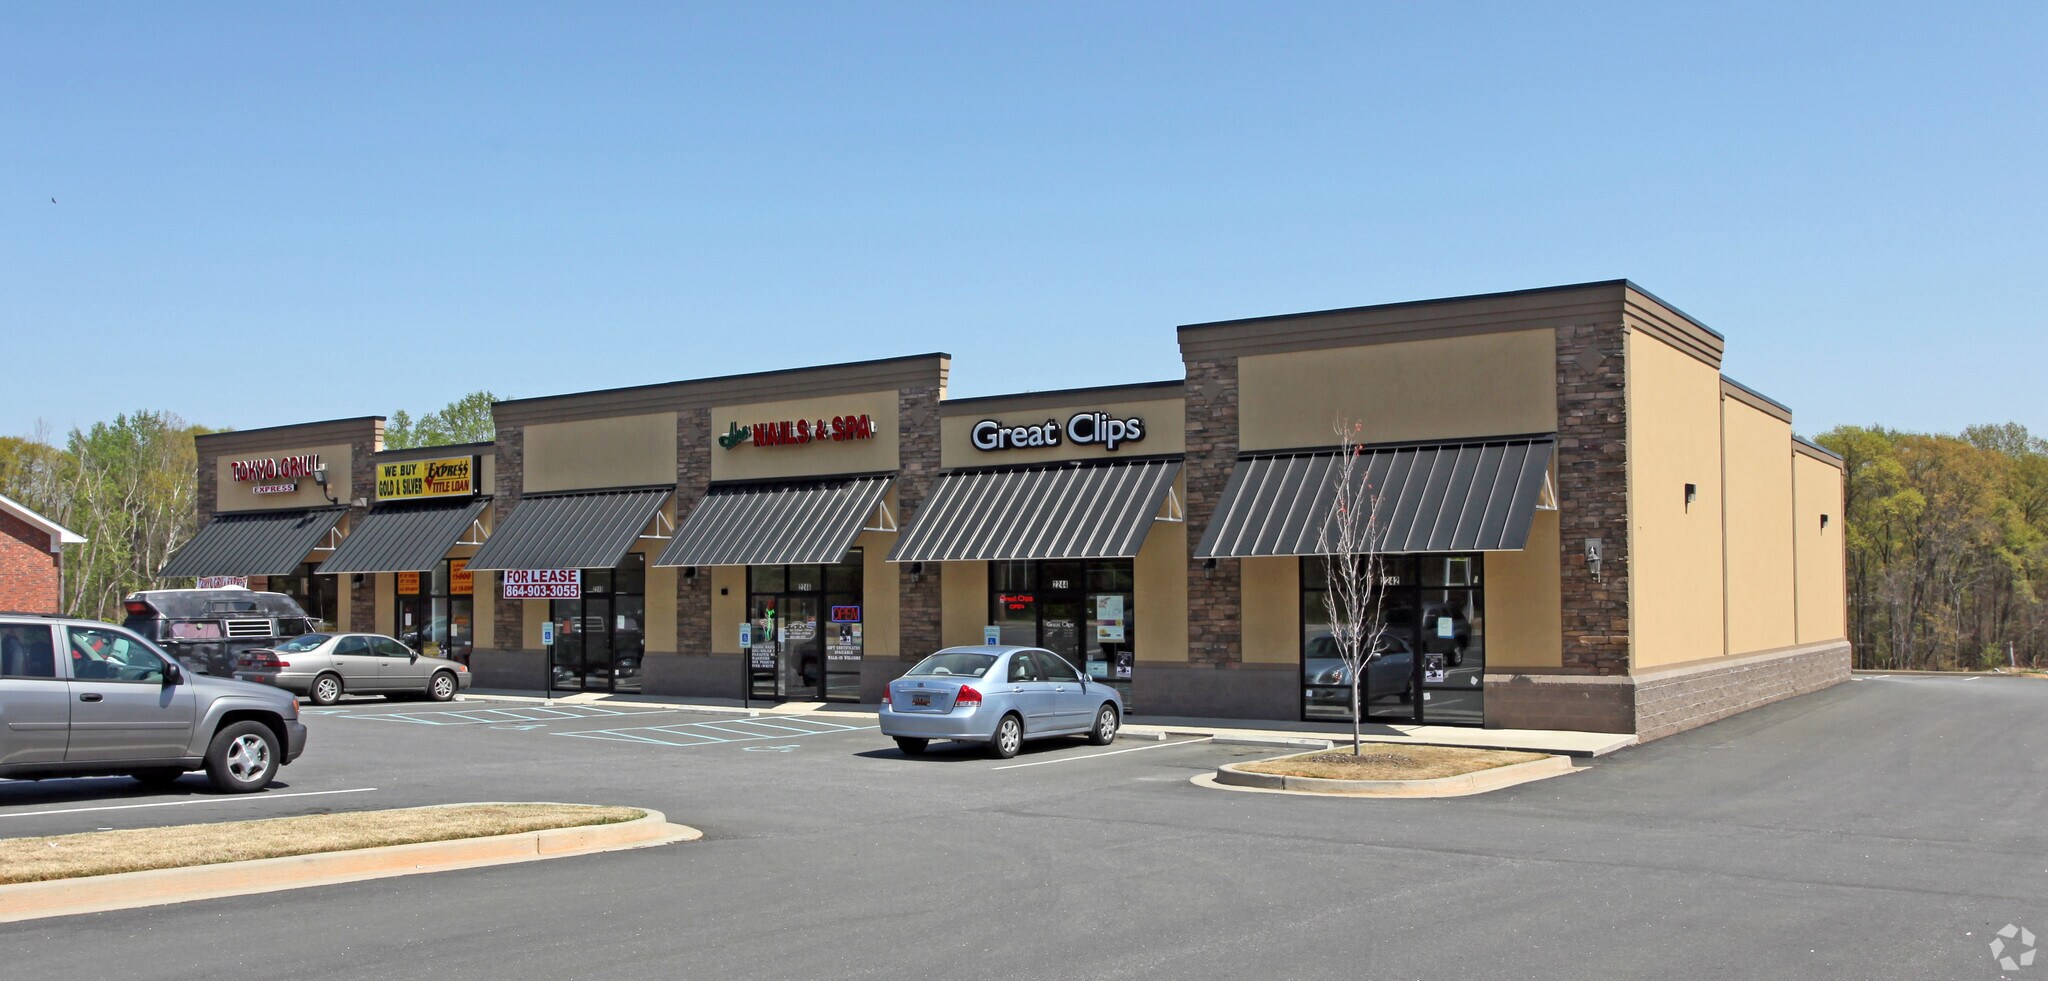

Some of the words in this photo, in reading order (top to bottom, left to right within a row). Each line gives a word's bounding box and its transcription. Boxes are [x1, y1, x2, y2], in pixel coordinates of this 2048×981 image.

[753, 418, 811, 448] NAILS
[815, 418, 828, 441] &
[831, 413, 873, 442] SPA
[972, 420, 1058, 450] Great
[1067, 412, 1142, 449] Clips
[231, 457, 277, 482] TOKYO
[280, 453, 320, 479] GRILL
[384, 465, 397, 478] WE
[399, 463, 418, 477] BUY
[254, 484, 294, 494] EXPRESS
[378, 479, 395, 497] GOLD
[396, 479, 401, 496] &
[402, 477, 423, 496] SILVER
[432, 480, 450, 494] TITLE
[451, 479, 470, 492] LOAN
[506, 569, 529, 584] FOR
[531, 568, 577, 583] LEASE
[506, 584, 577, 597] 864-903-3055
[833, 607, 859, 620] OPEN
